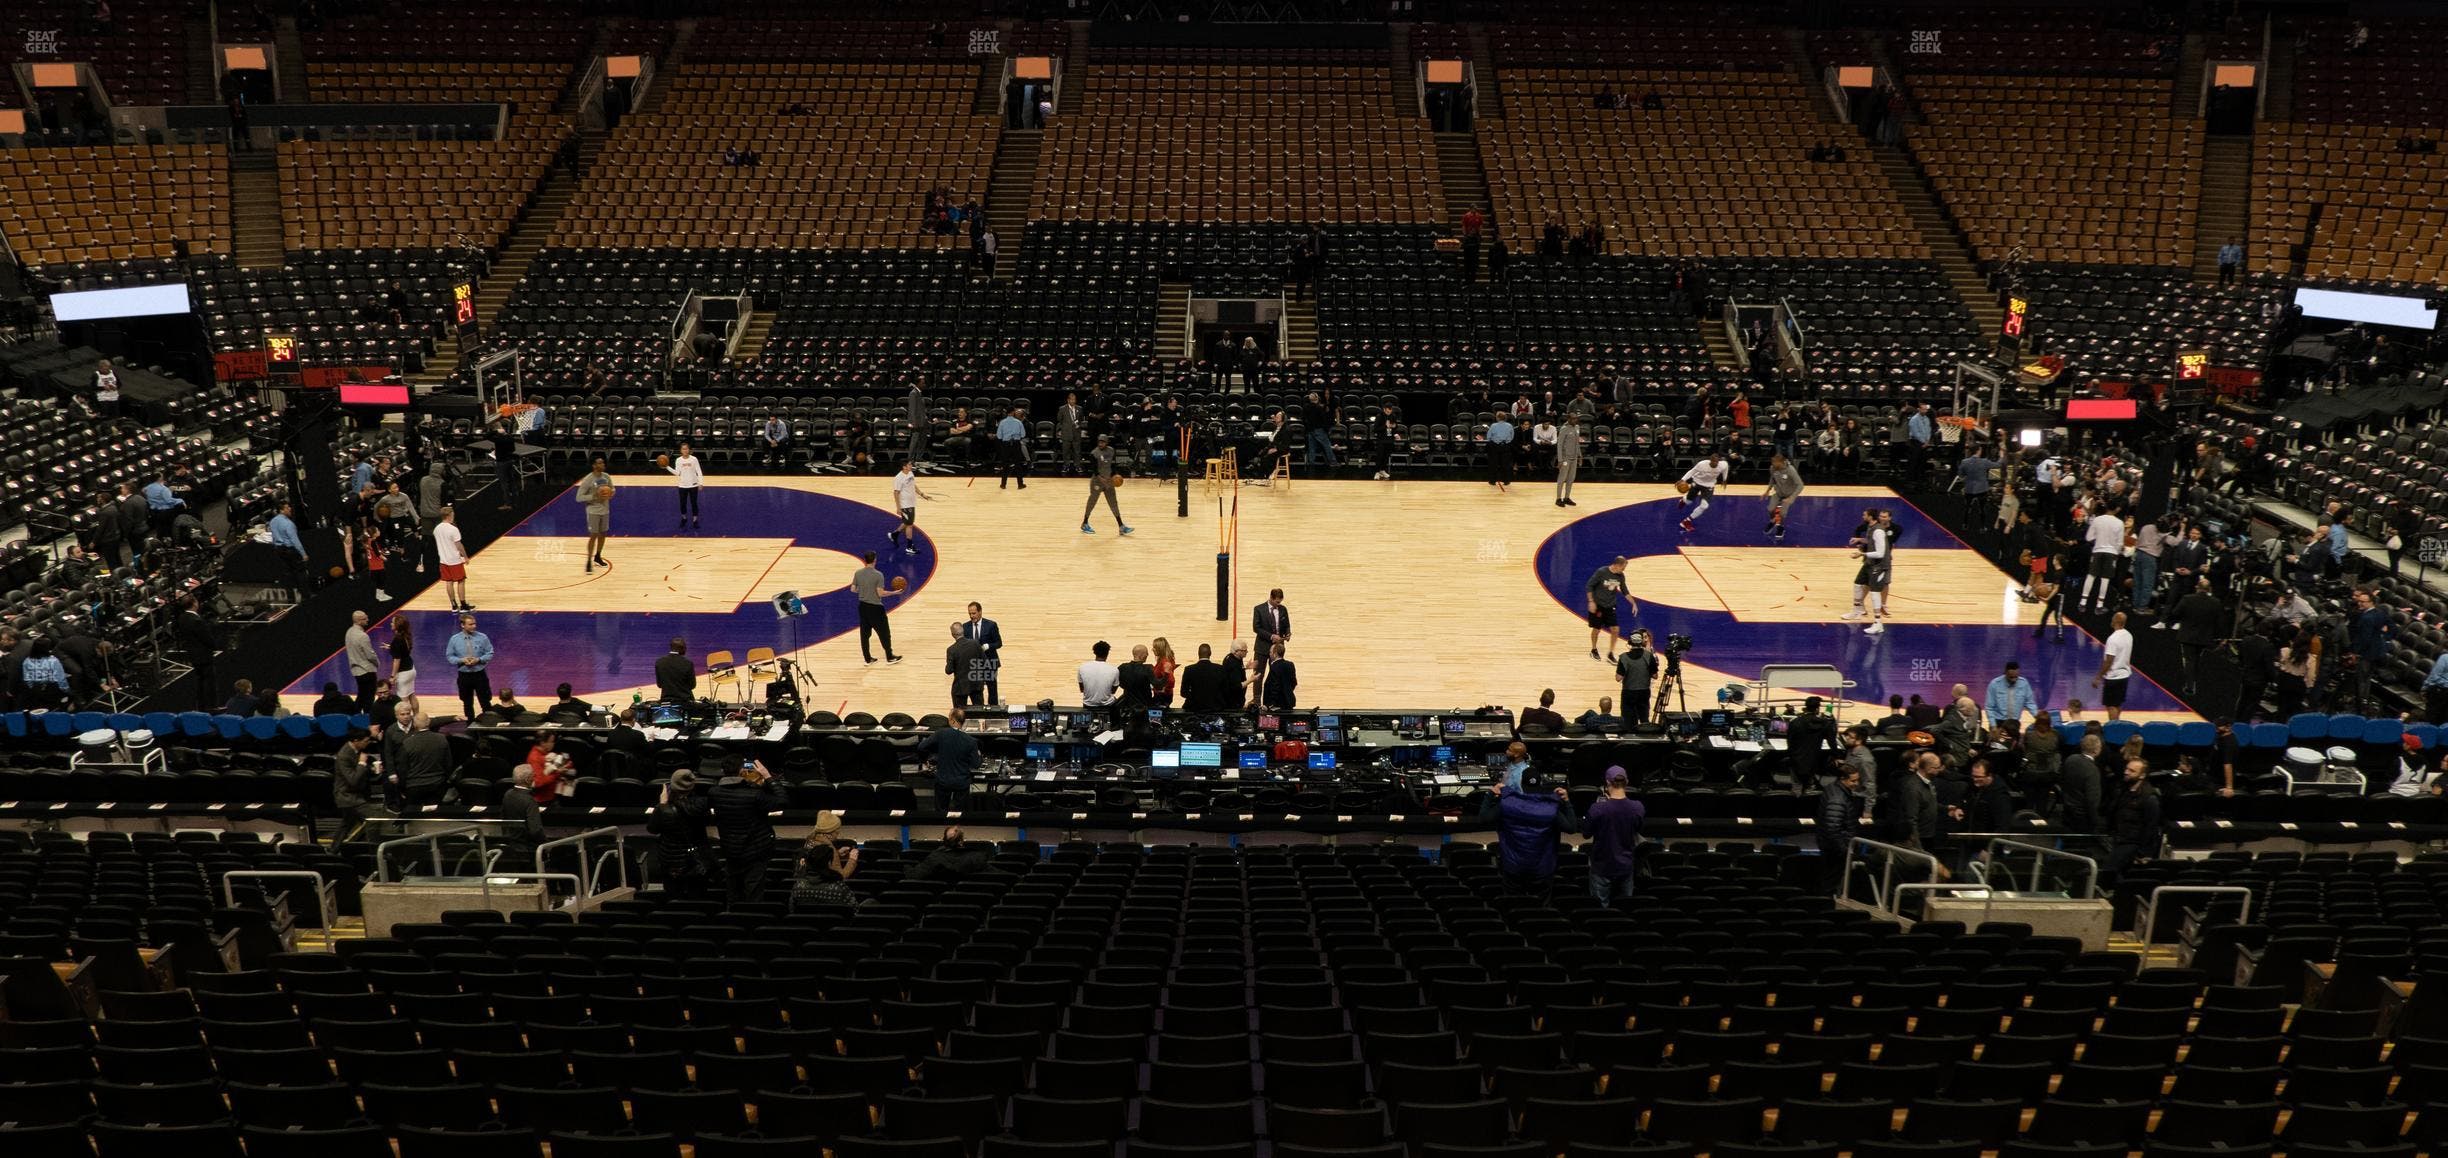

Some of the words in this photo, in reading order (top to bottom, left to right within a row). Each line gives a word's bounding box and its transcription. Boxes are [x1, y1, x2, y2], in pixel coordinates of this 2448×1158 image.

[457, 299, 472, 322] 24
[2006, 311, 2022, 334] 24
[273, 348, 290, 361] 24
[2183, 365, 2201, 377] 24
